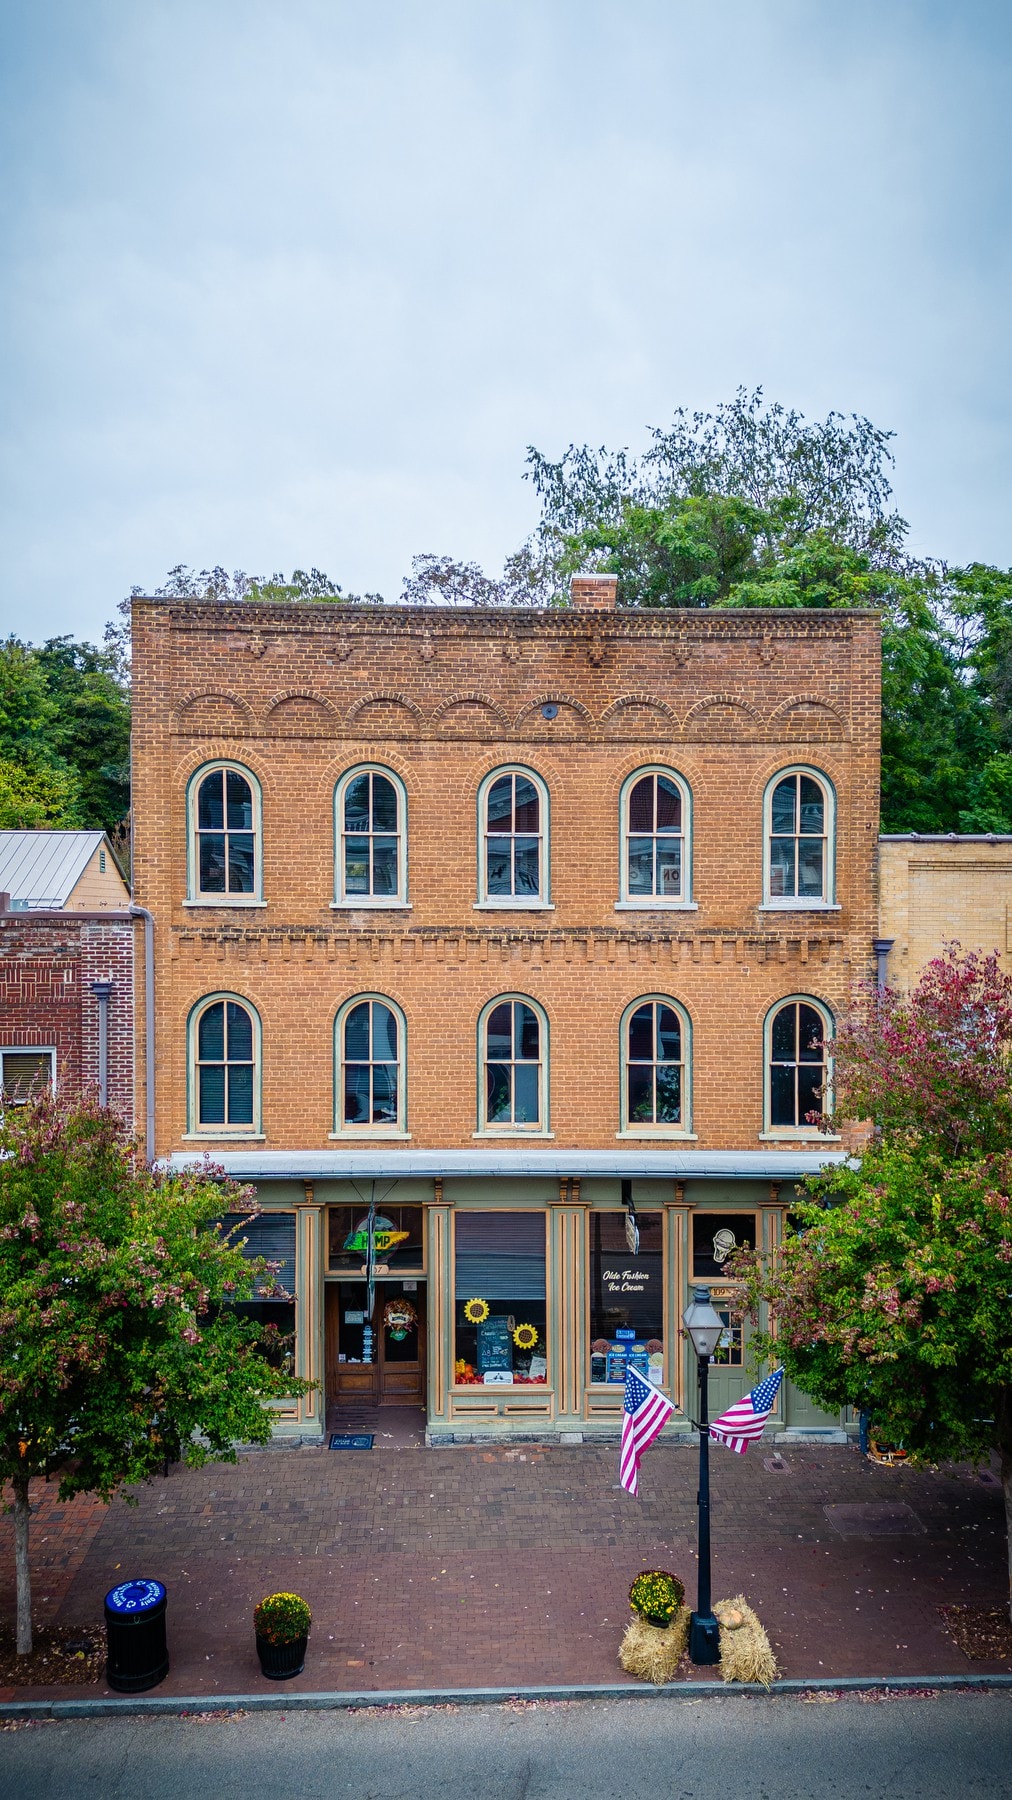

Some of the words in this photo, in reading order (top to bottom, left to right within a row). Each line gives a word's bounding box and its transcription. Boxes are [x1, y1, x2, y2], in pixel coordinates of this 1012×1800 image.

[361, 1235, 391, 1248] HMP
[603, 1270, 621, 1281] Olde
[621, 1270, 650, 1281] Fashion
[608, 1281, 620, 1292] Ice
[621, 1281, 644, 1292] Cream
[713, 1288, 726, 1296] 109
[141, 1597, 156, 1606] Only
